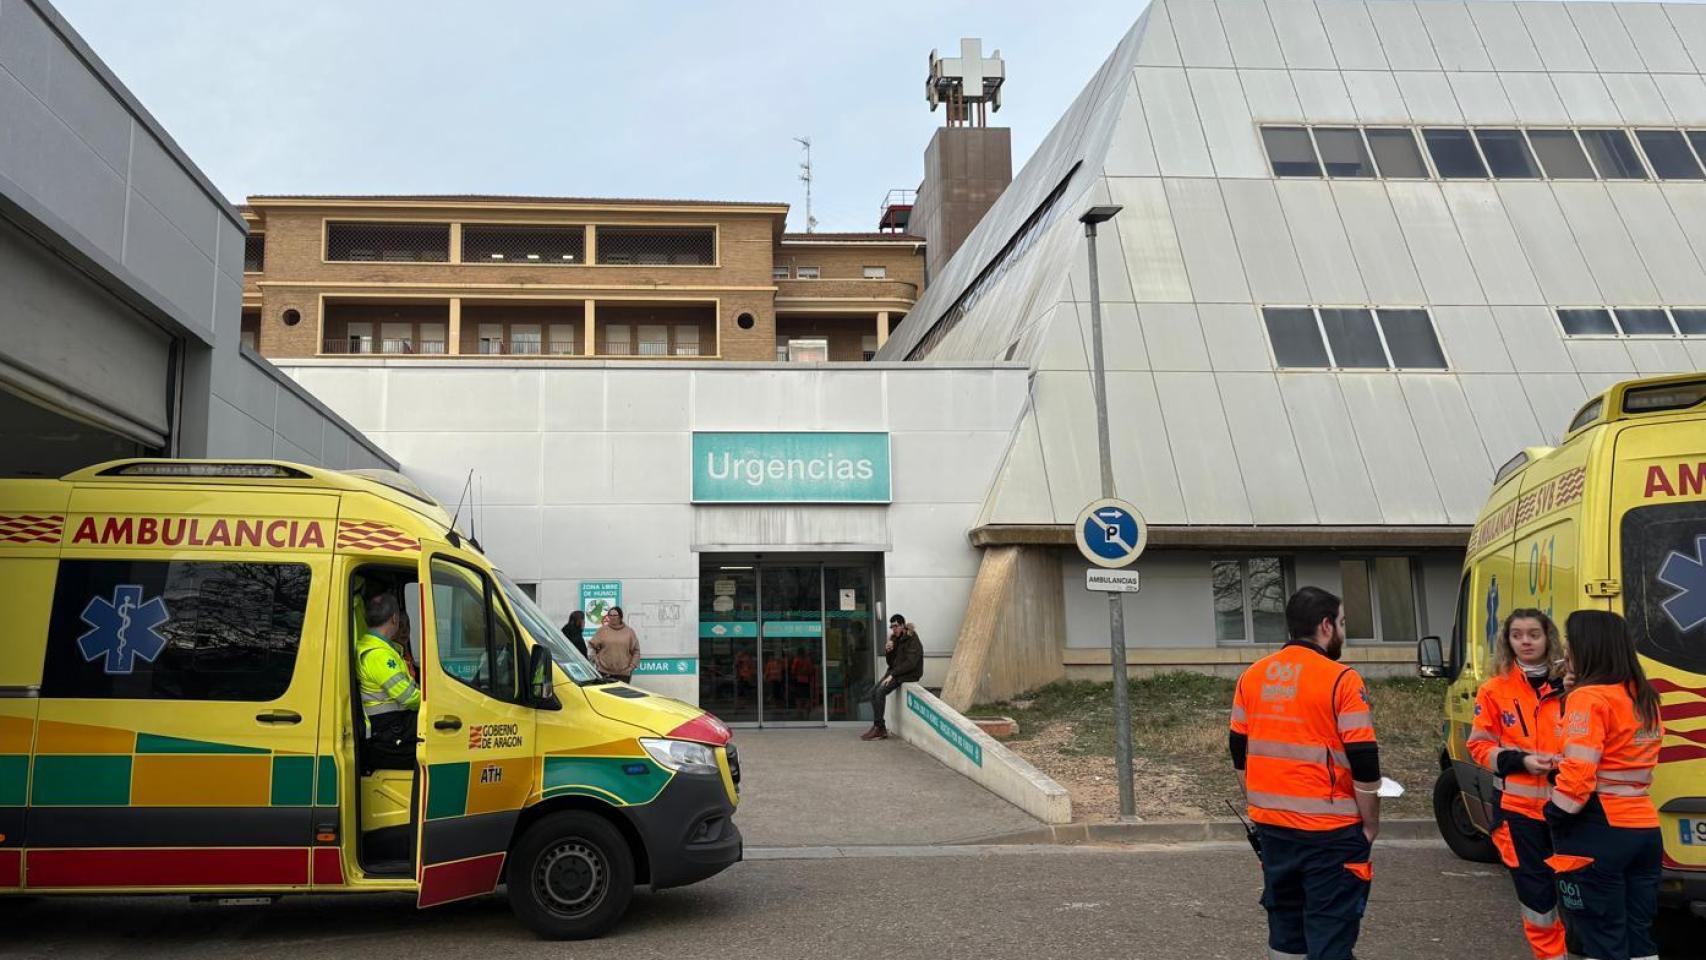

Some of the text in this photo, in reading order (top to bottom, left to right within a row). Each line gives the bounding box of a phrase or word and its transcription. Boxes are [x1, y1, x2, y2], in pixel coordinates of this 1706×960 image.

[707, 450, 874, 486] Urgencias
[72, 516, 325, 548] AMBULANCIA
[1105, 525, 1118, 541] P
[1529, 534, 1555, 596] 061
[1088, 576, 1137, 585] AMBULANCIAS
[639, 661, 669, 671] UMAR
[1266, 660, 1304, 682] 061
[482, 724, 518, 737] GOBIERNO
[481, 738, 492, 749] DE
[480, 768, 502, 783] ATH
[1559, 879, 1581, 897] 061
